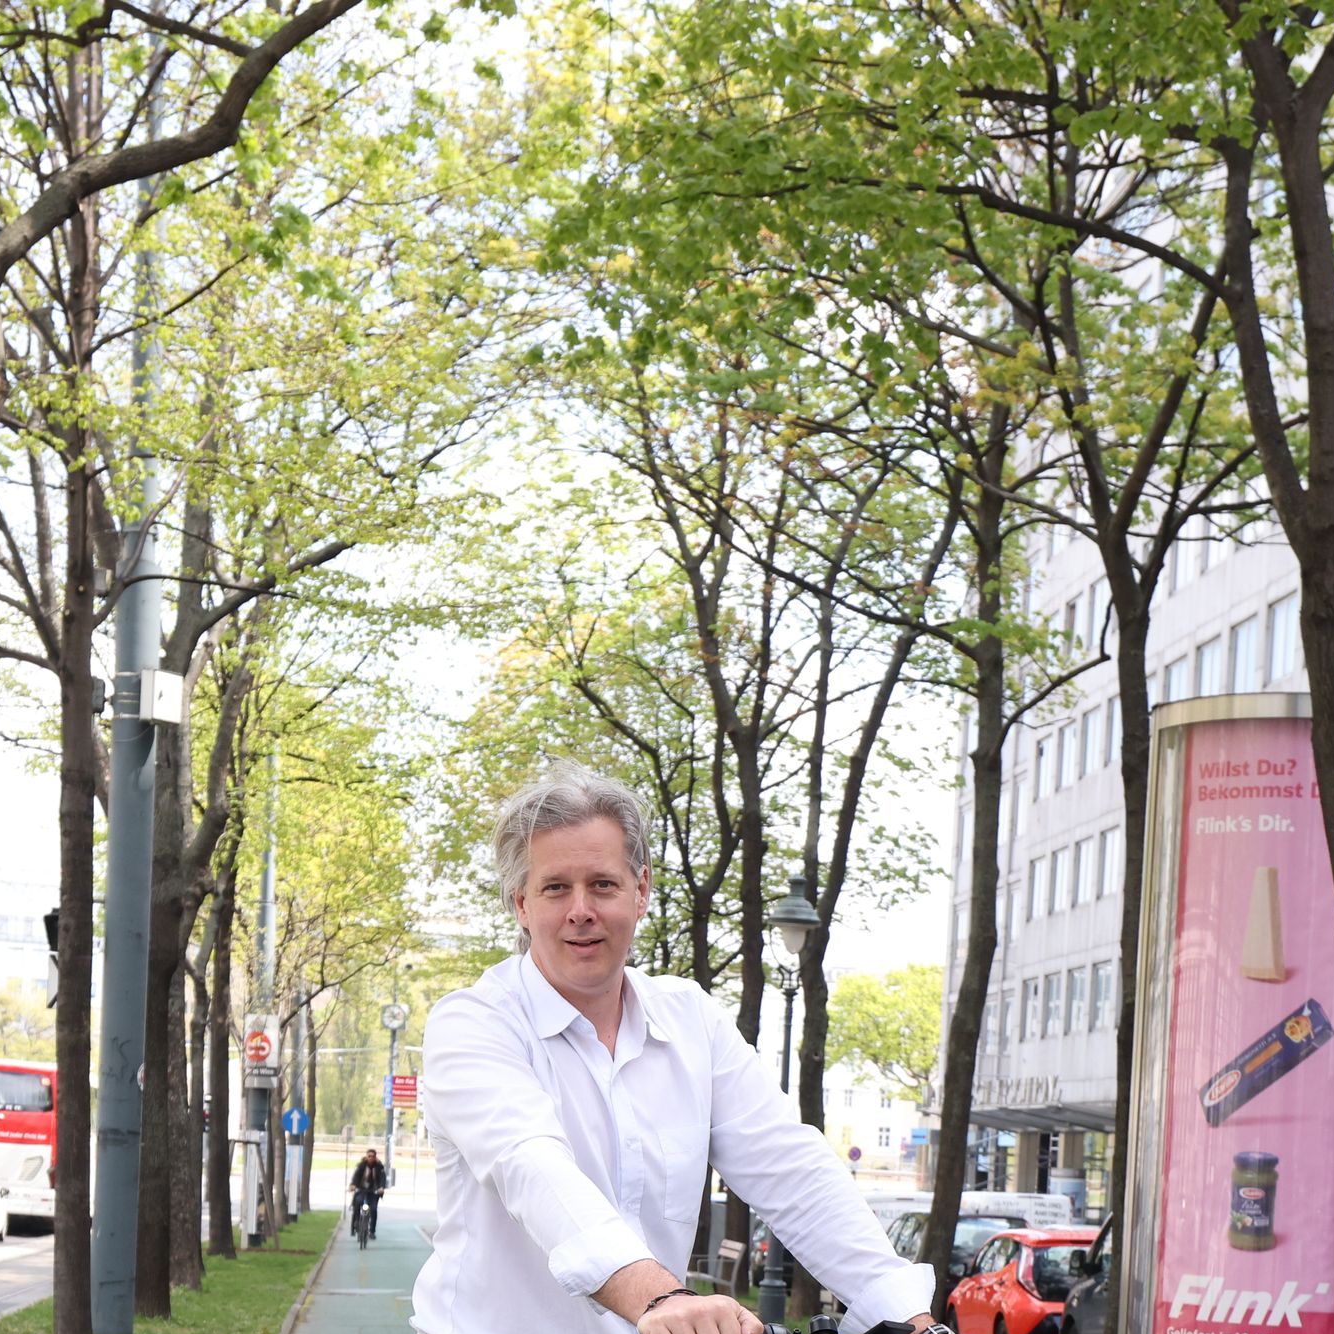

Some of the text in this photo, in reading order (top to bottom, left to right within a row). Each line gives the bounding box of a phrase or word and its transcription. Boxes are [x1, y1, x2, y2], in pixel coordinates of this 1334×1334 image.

[1199, 758, 1297, 779] Willst Du?
[1198, 782, 1303, 801] Bekommst
[1258, 814, 1295, 832] Dir.
[1168, 1274, 1330, 1328] Flink
